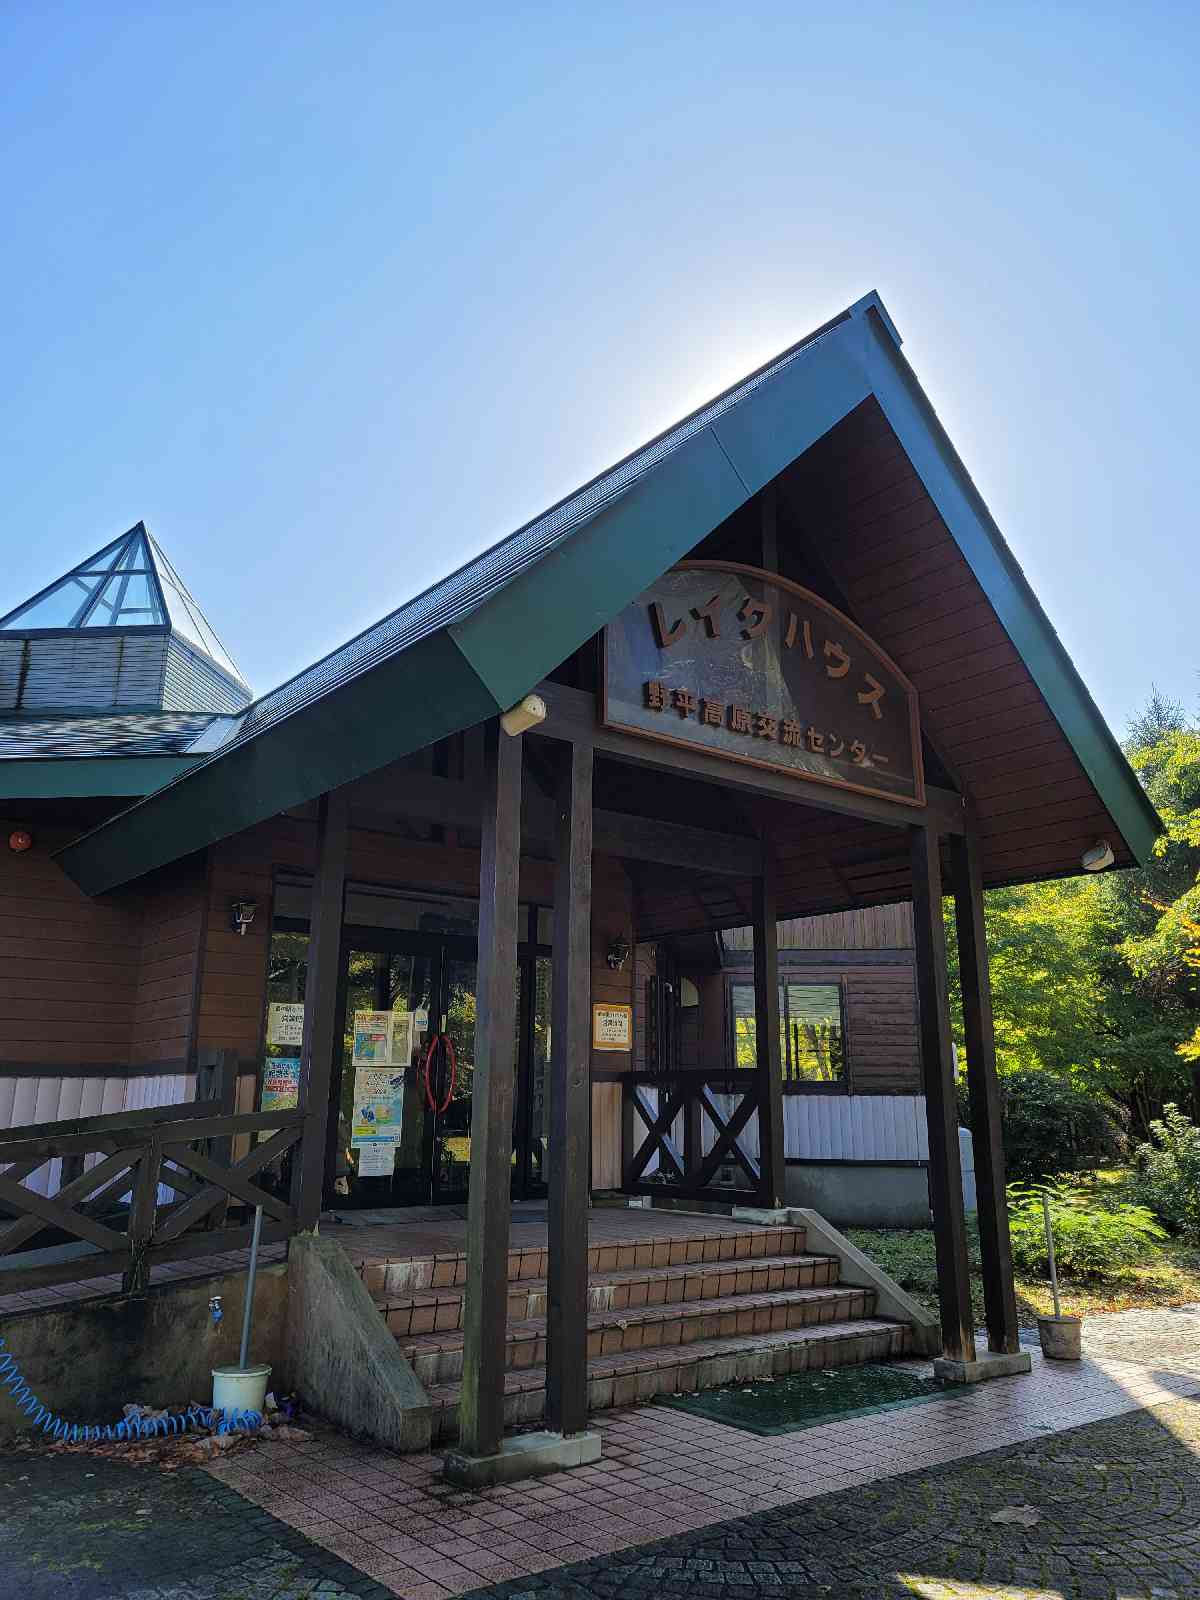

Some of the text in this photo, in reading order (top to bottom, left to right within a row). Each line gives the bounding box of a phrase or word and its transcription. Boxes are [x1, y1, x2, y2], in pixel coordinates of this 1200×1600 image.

[648, 594, 886, 720] レイクハウス
[643, 679, 889, 764] 野平高原交流センター
